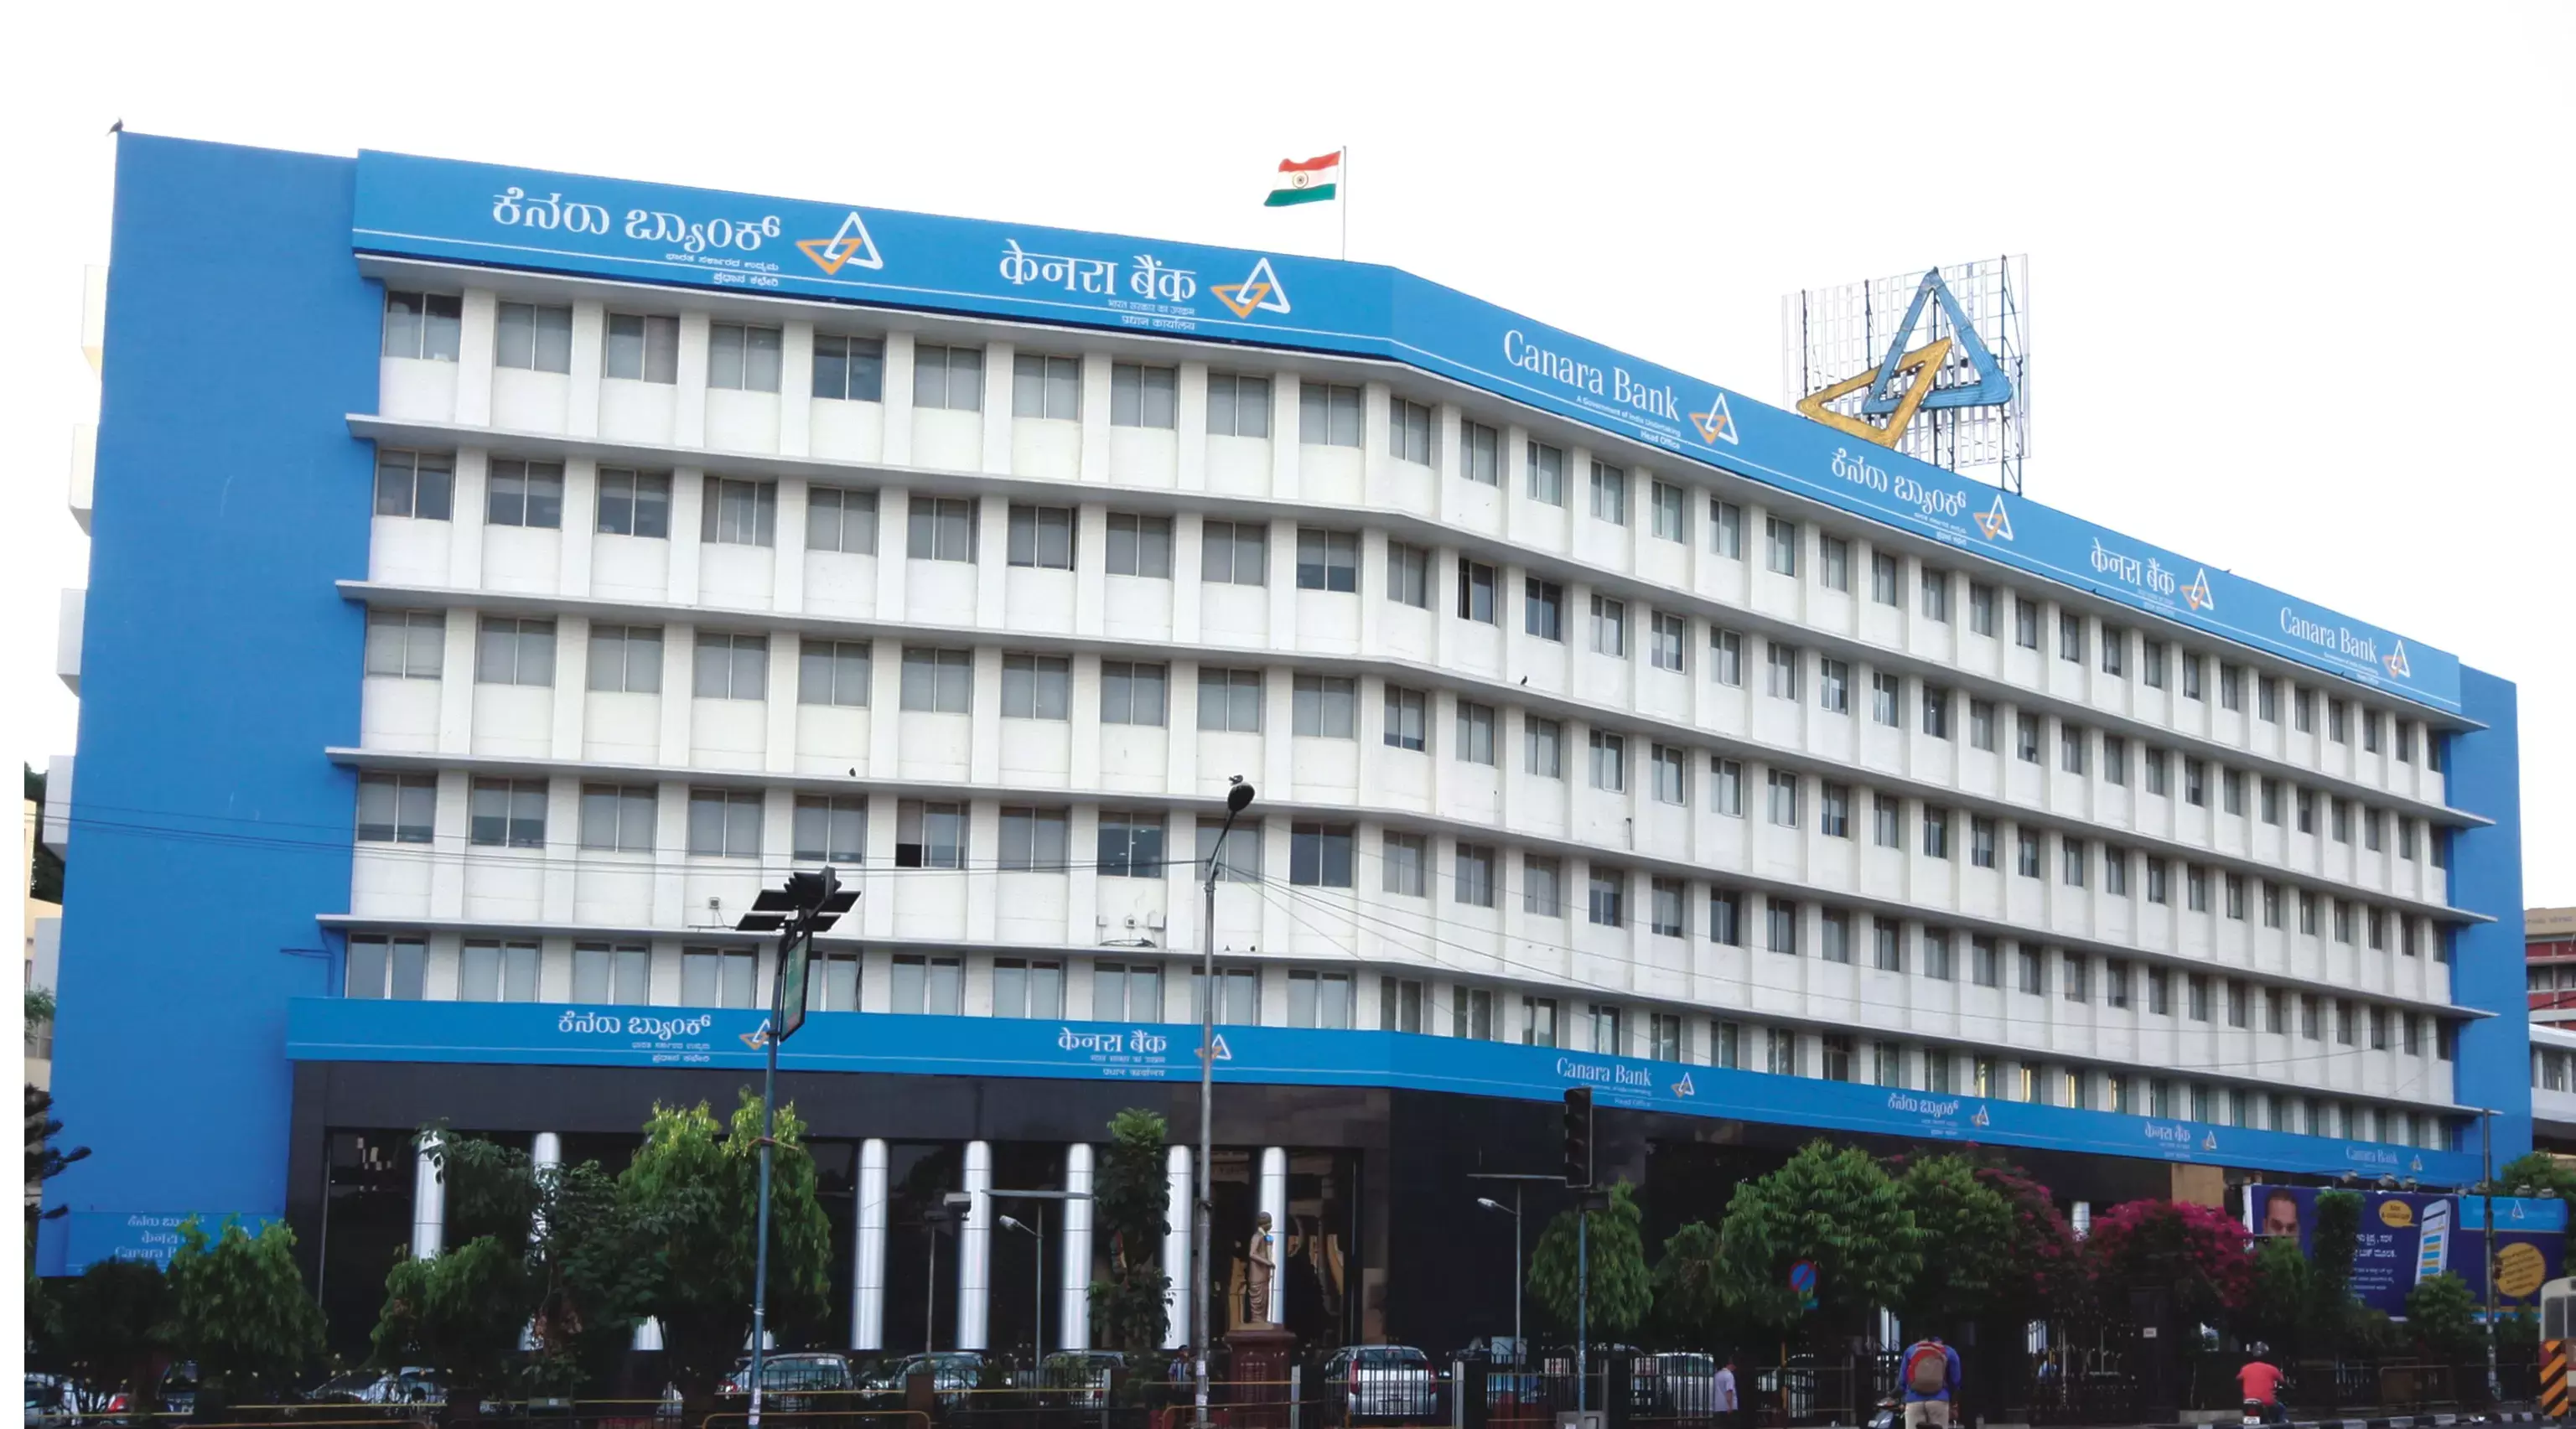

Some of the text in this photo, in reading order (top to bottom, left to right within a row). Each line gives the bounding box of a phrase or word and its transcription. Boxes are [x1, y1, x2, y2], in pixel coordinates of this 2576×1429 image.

[492, 186, 781, 253] ಕೆನರಾ ಬ್ಯಾಂಕ್
[999, 239, 1197, 302] केनरा बैंक
[1504, 330, 1681, 422] Canara Bank
[1640, 429, 1659, 443] Head
[1832, 448, 1967, 516] ಕೆನರಾ ಬ್ಯಾಂಕ್
[2091, 536, 2174, 595] केनरा बैंक
[2280, 607, 2377, 663] Canara Bank
[558, 1010, 711, 1041] ಕೆನರಾ ಬ್ಯಾಂಕ್
[1058, 1027, 1167, 1054] केनरा बैंक
[1557, 1057, 1651, 1086] Canara Bank
